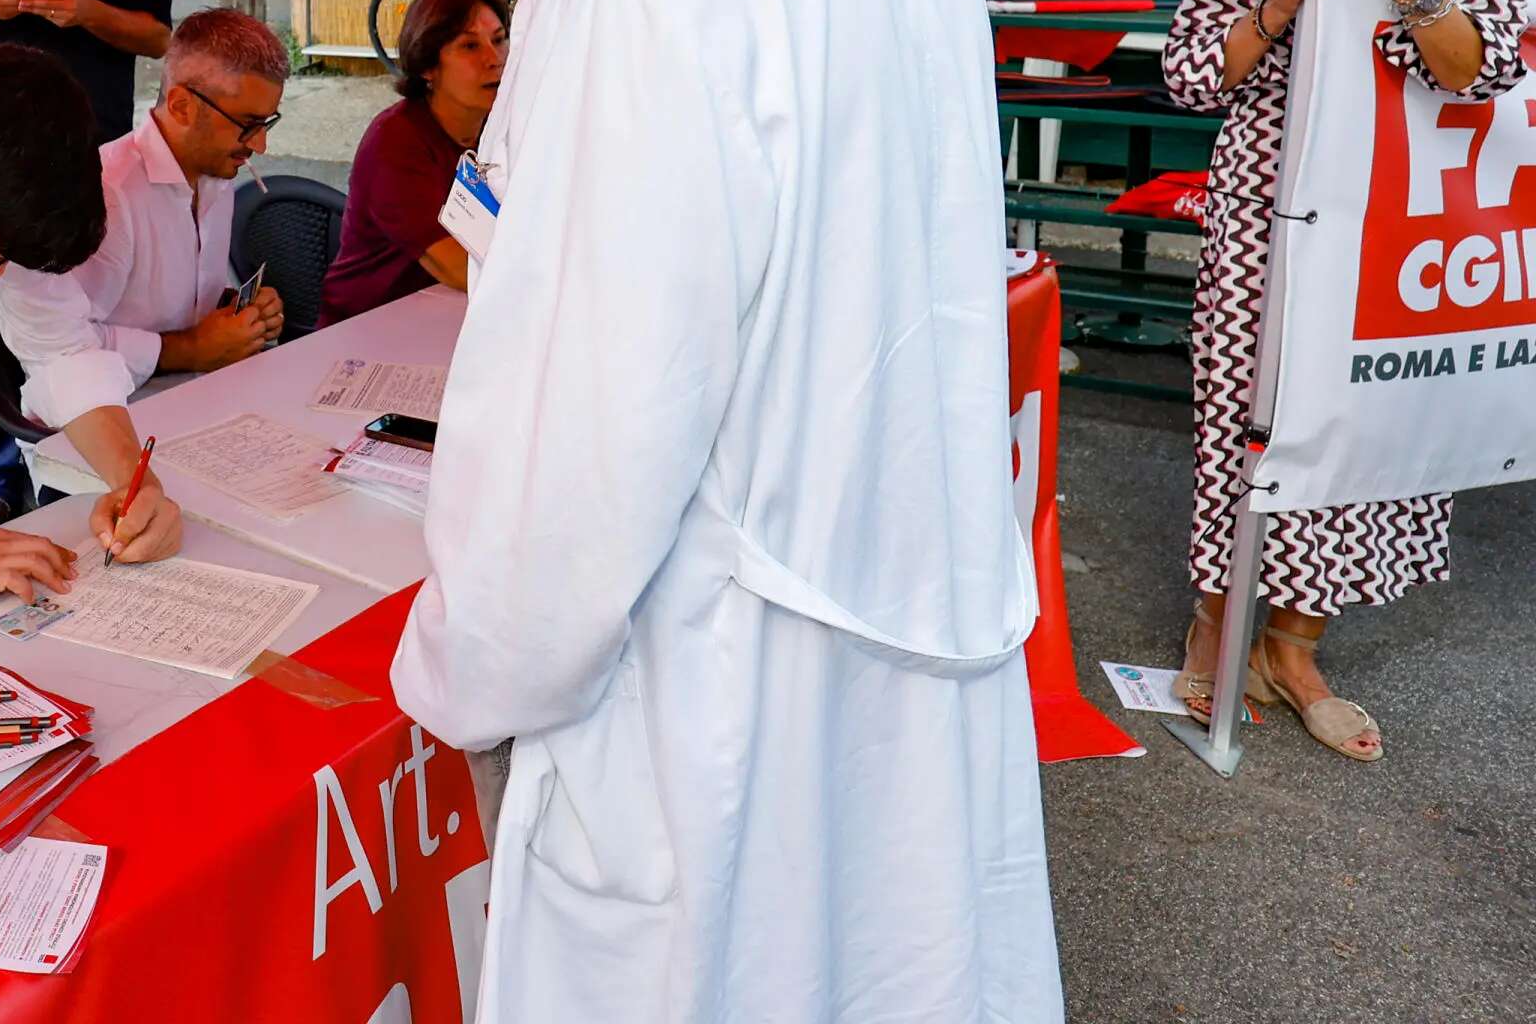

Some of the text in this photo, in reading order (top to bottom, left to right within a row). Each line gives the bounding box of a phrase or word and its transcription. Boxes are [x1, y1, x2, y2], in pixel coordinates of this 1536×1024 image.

[1350, 347, 1456, 384] ROMA
[1467, 343, 1486, 373] E
[312, 723, 461, 962] Art.
